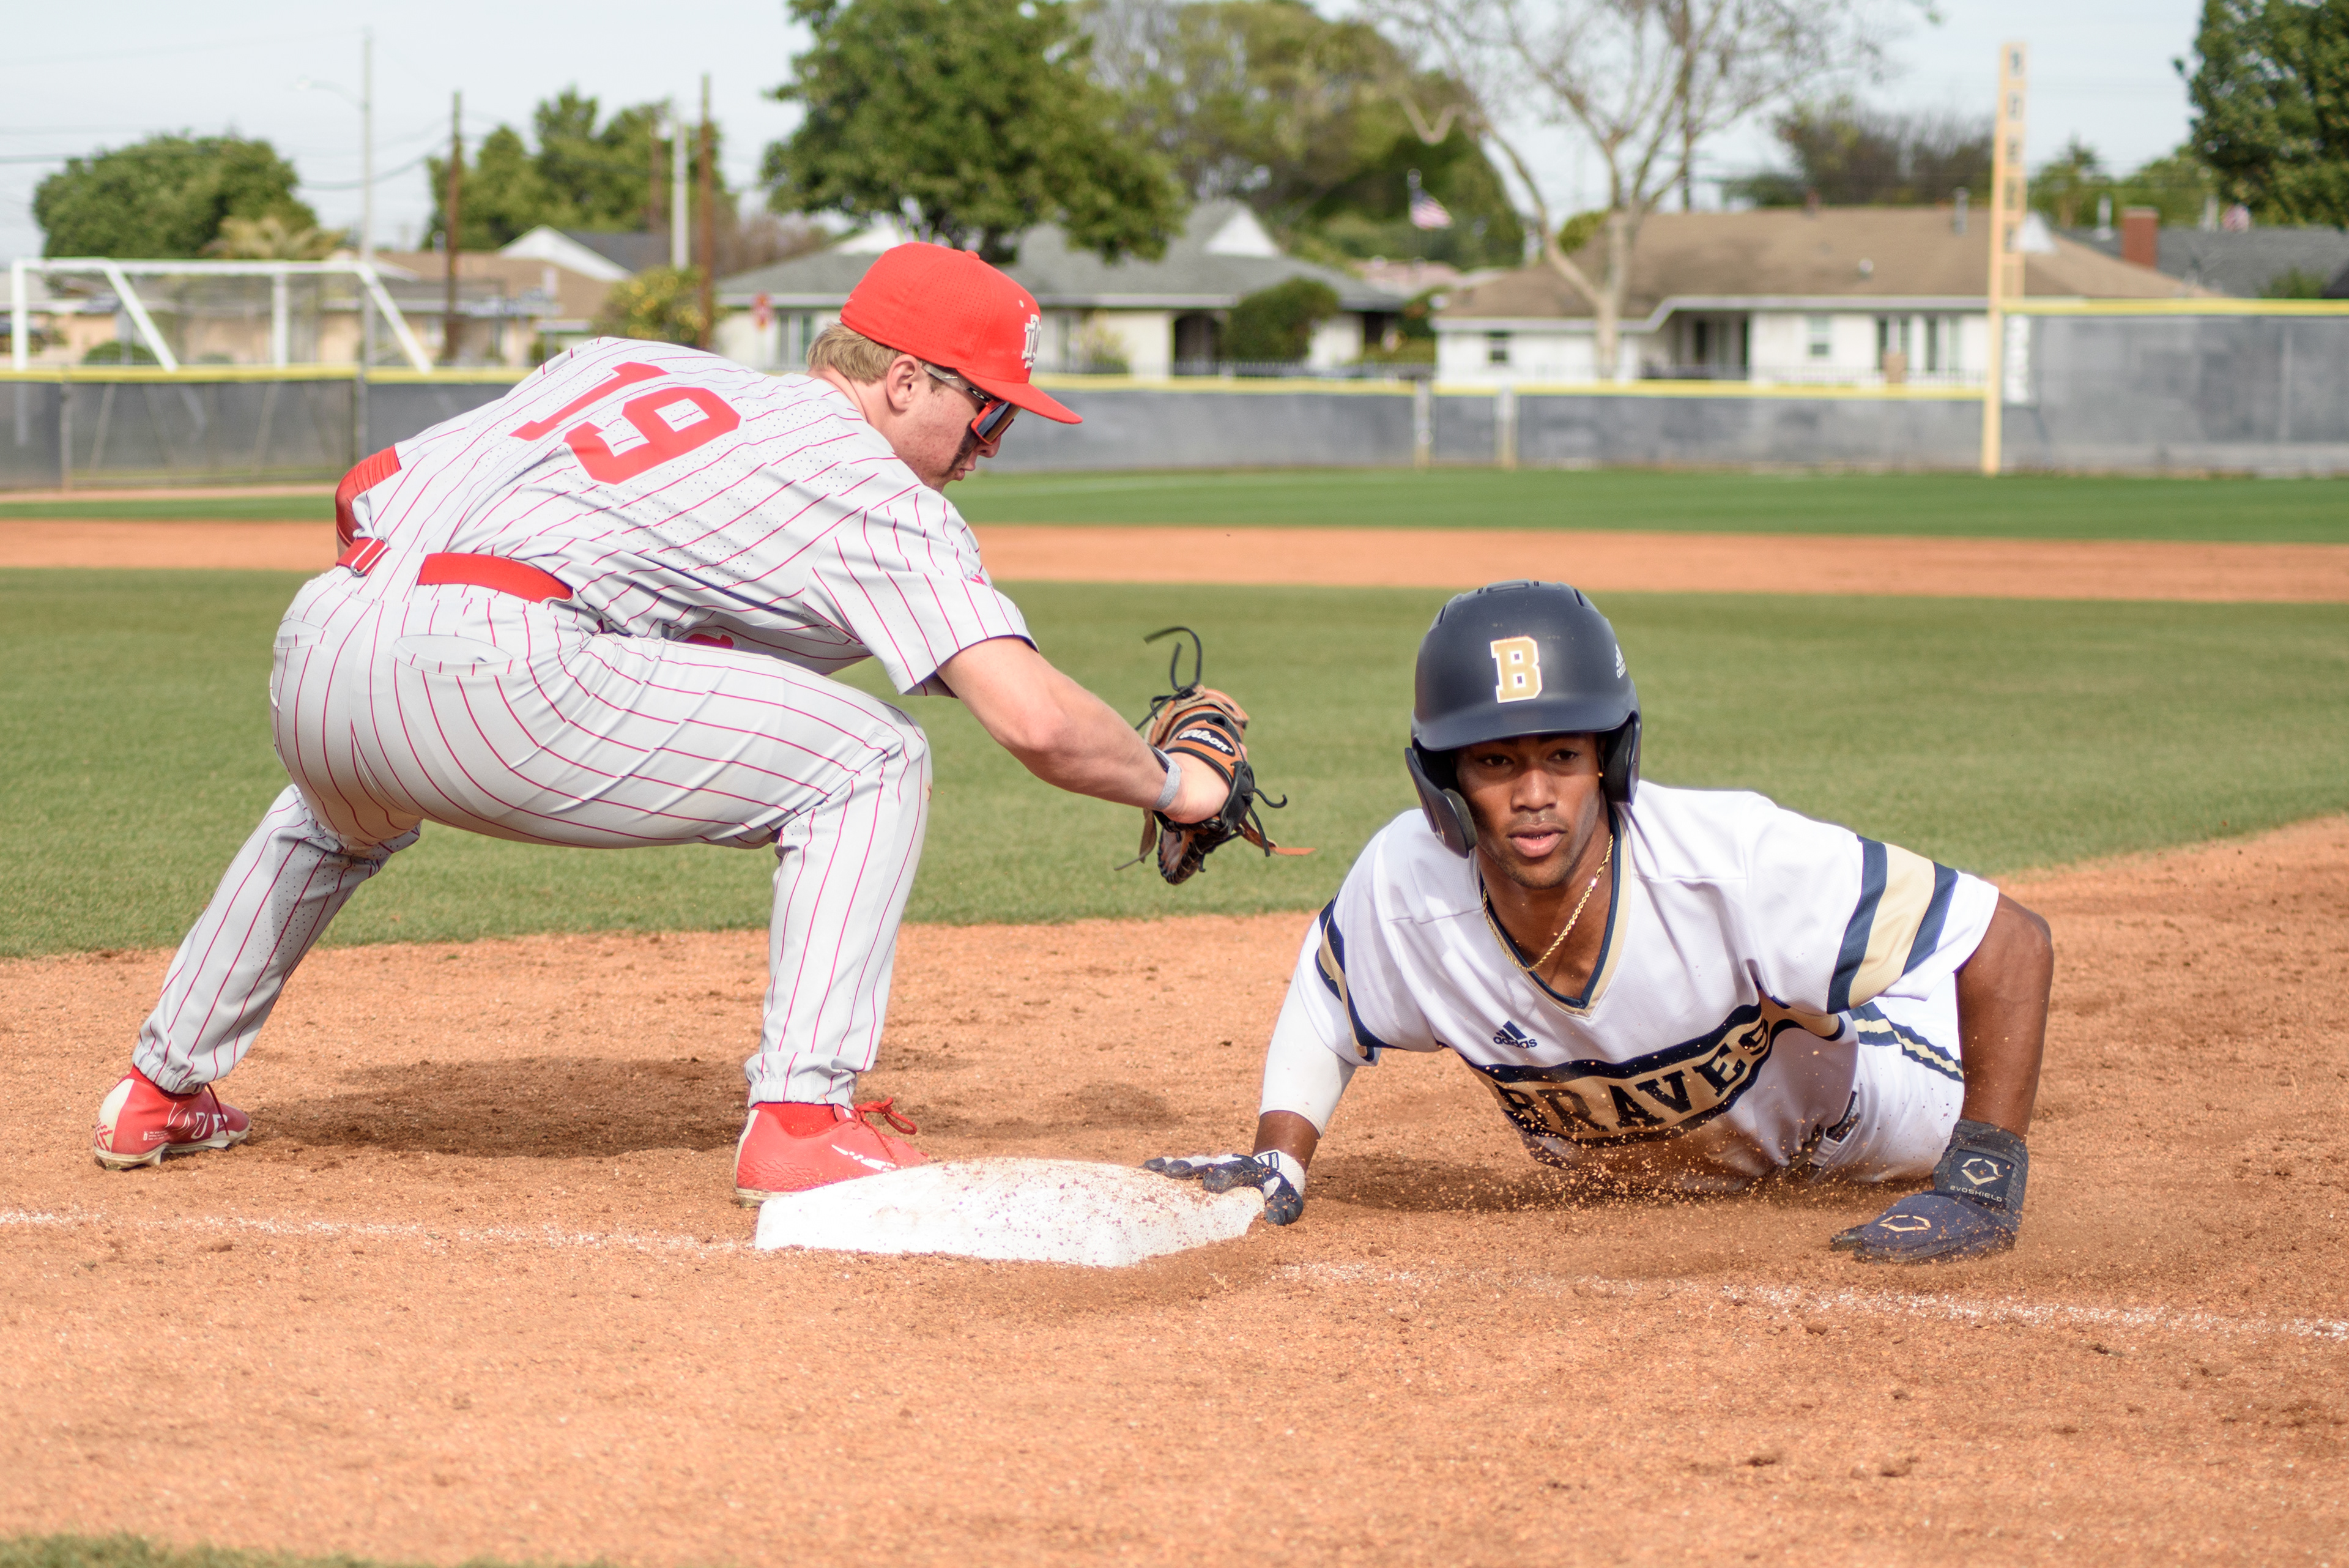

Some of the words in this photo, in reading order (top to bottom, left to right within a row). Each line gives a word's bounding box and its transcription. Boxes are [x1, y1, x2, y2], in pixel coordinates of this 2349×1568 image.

[508, 362, 741, 485] 19
[1490, 636, 1542, 703] B
[1492, 1018, 1768, 1132] BRAVES
[1493, 1036, 1537, 1049] adidas
